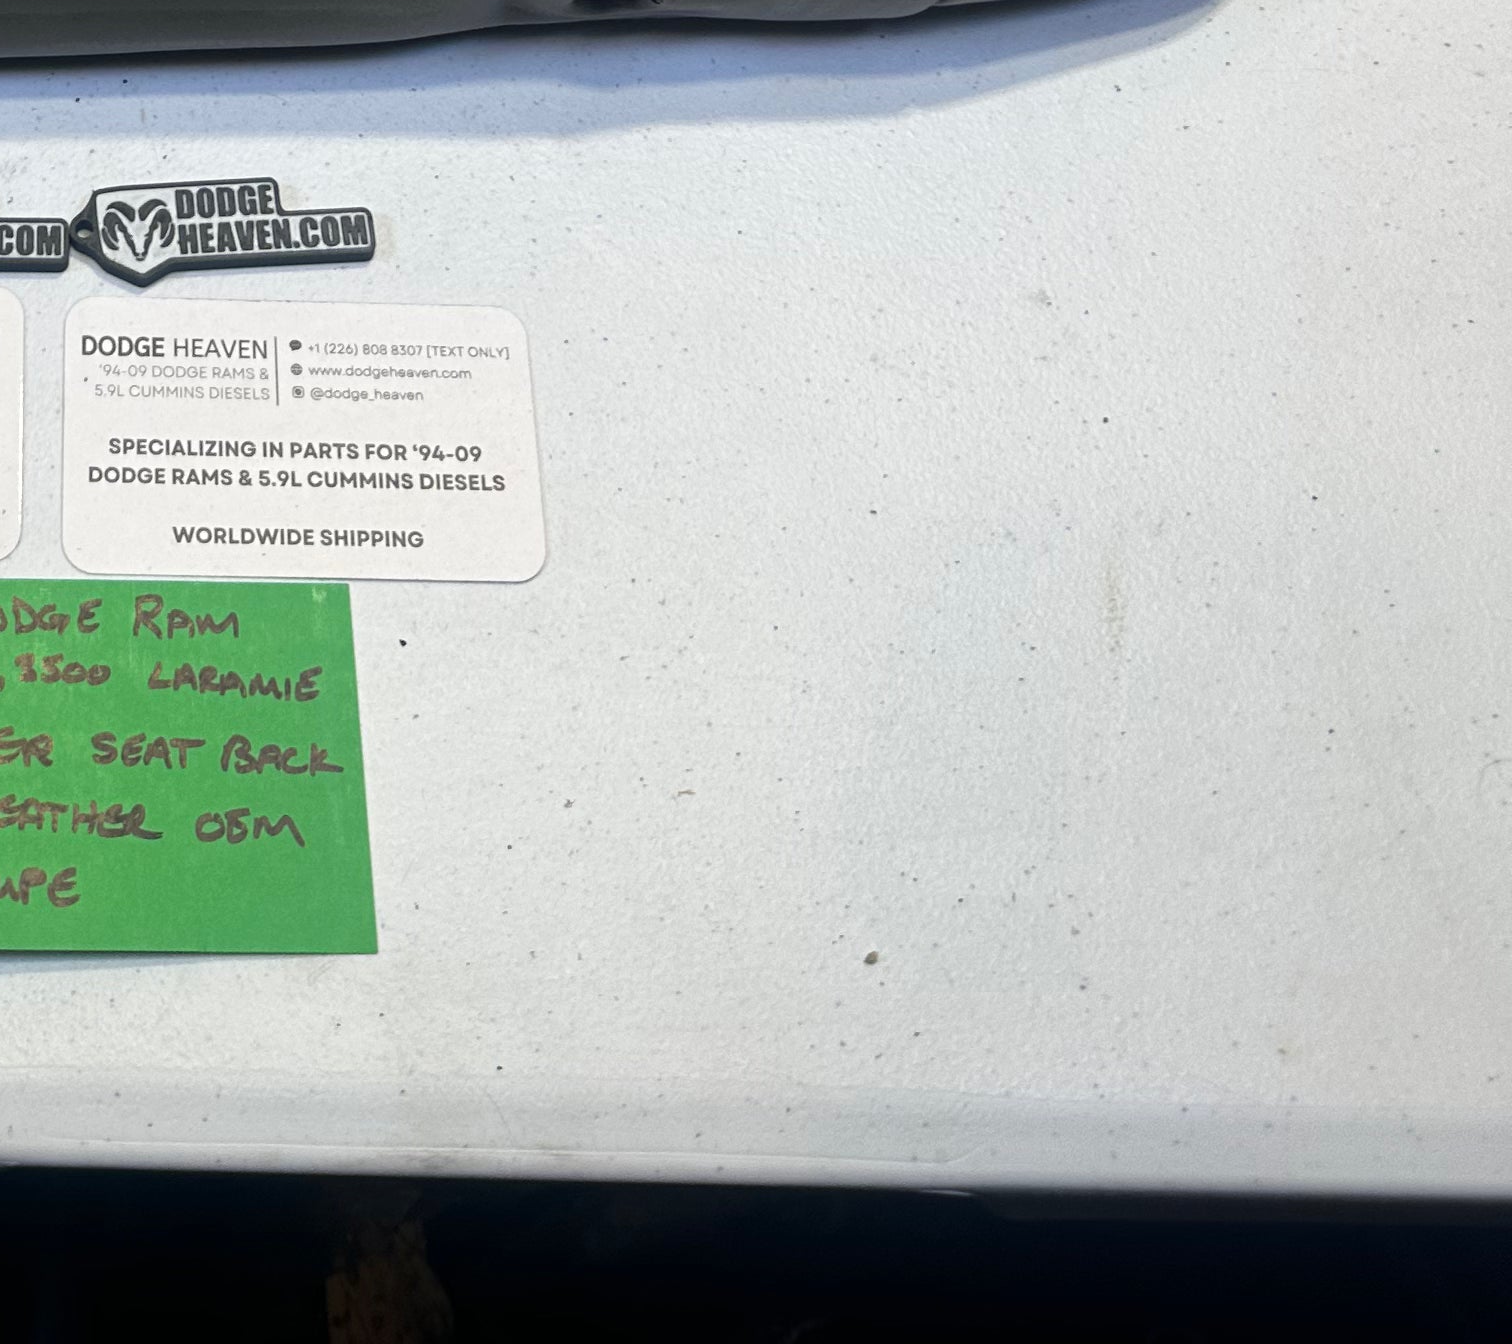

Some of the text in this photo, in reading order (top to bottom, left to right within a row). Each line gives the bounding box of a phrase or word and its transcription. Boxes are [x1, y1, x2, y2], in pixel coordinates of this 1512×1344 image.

[175, 184, 276, 219] DODGE
[176, 214, 368, 254] HEAVEN.COM
[81, 335, 268, 359] DODGE HEAVEN
[308, 343, 509, 360] +1 (226) 808 8307 [TEXT ONLY]
[99, 364, 269, 380] '94-09 DODGE RAMS &
[308, 366, 472, 379] www.dodgeheaven.com
[95, 384, 270, 400] 5.9L CUMMINS DIESELS
[310, 387, 423, 402] @dodge_heaven
[109, 437, 256, 457] SPECIALIZING
[262, 441, 283, 457] IN
[290, 442, 359, 460] PARTS
[365, 444, 407, 461] FOR
[89, 466, 505, 491] DODGE RAMS & 5.9L CUMMINS DIESELS
[172, 526, 424, 548] WORLDWIDE SHIPPING
[133, 594, 240, 640] RAM
[148, 661, 324, 703] LARAMIE
[92, 731, 207, 772] SEAT
[222, 734, 344, 775] BACK
[196, 811, 305, 847] OEM
